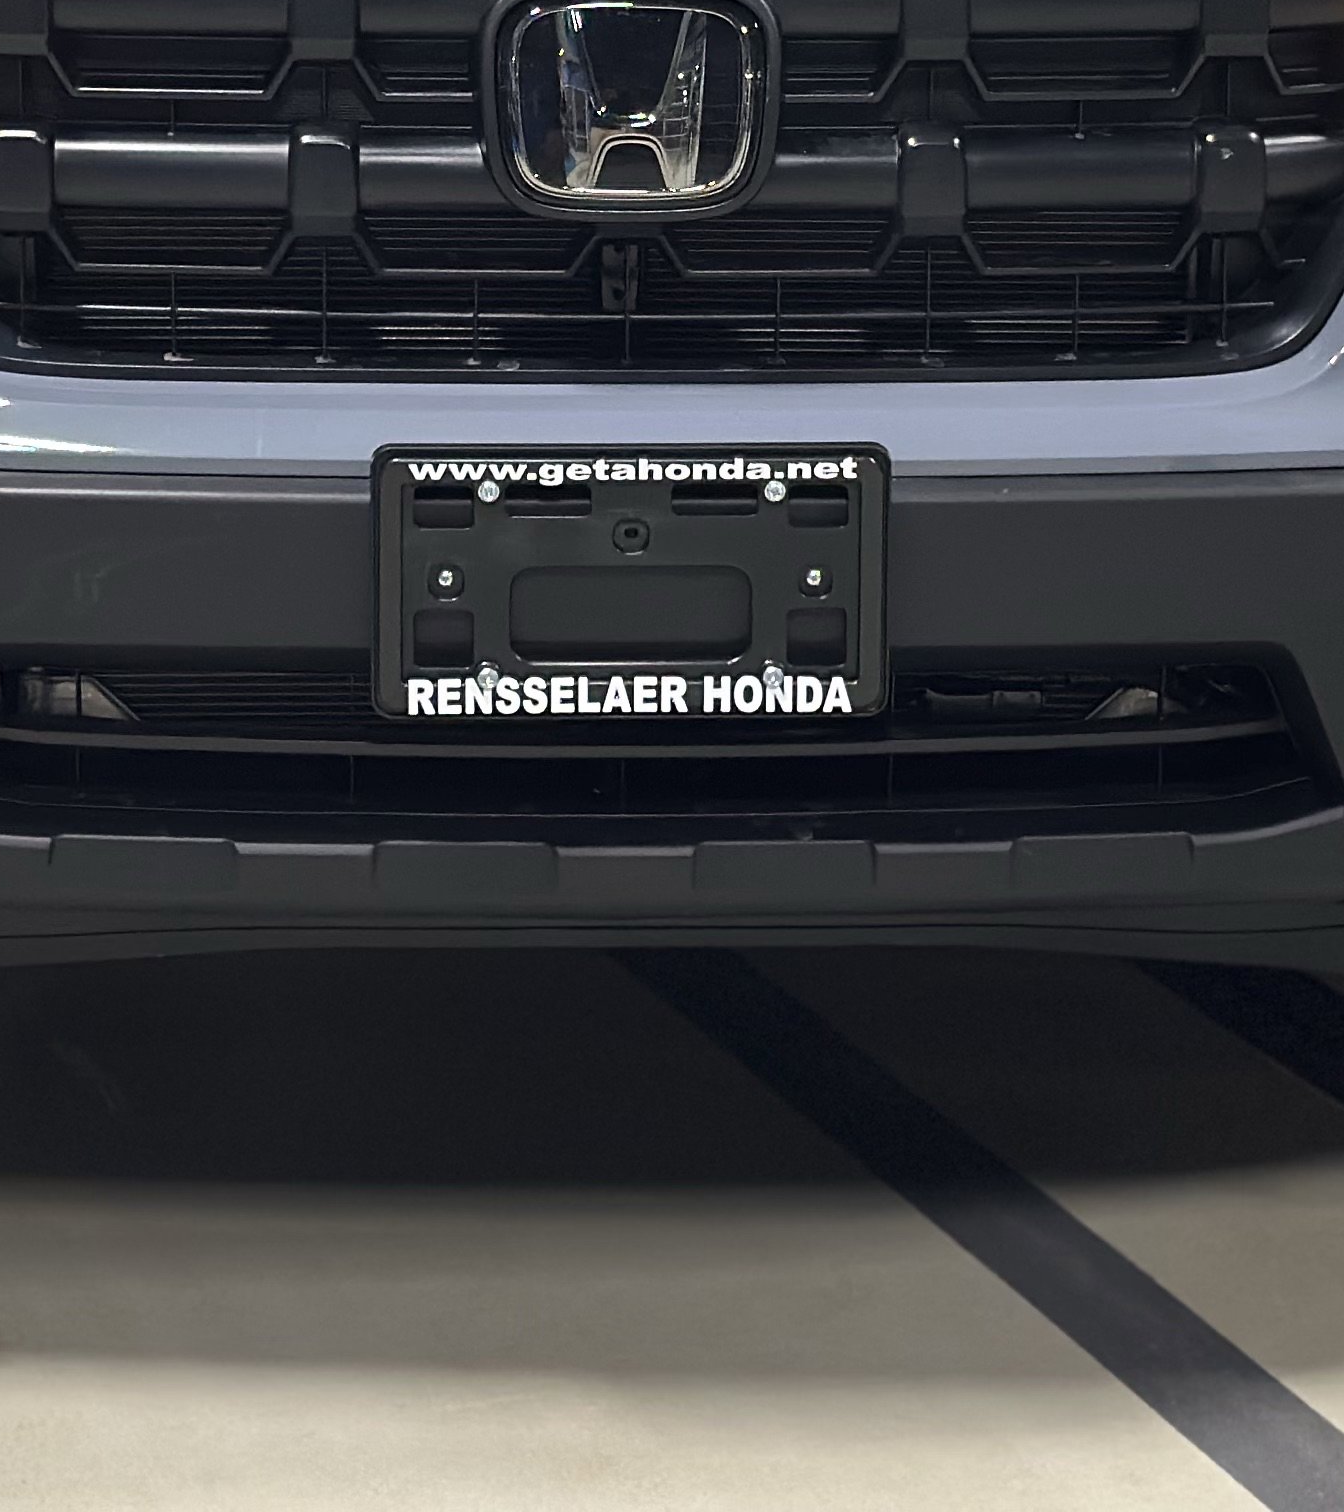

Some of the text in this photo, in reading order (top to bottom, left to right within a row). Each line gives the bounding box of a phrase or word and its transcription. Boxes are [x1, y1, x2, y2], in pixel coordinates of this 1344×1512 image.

[407, 457, 858, 486] www.getahonda.net
[407, 675, 852, 715] RENSSELAER HONDA
